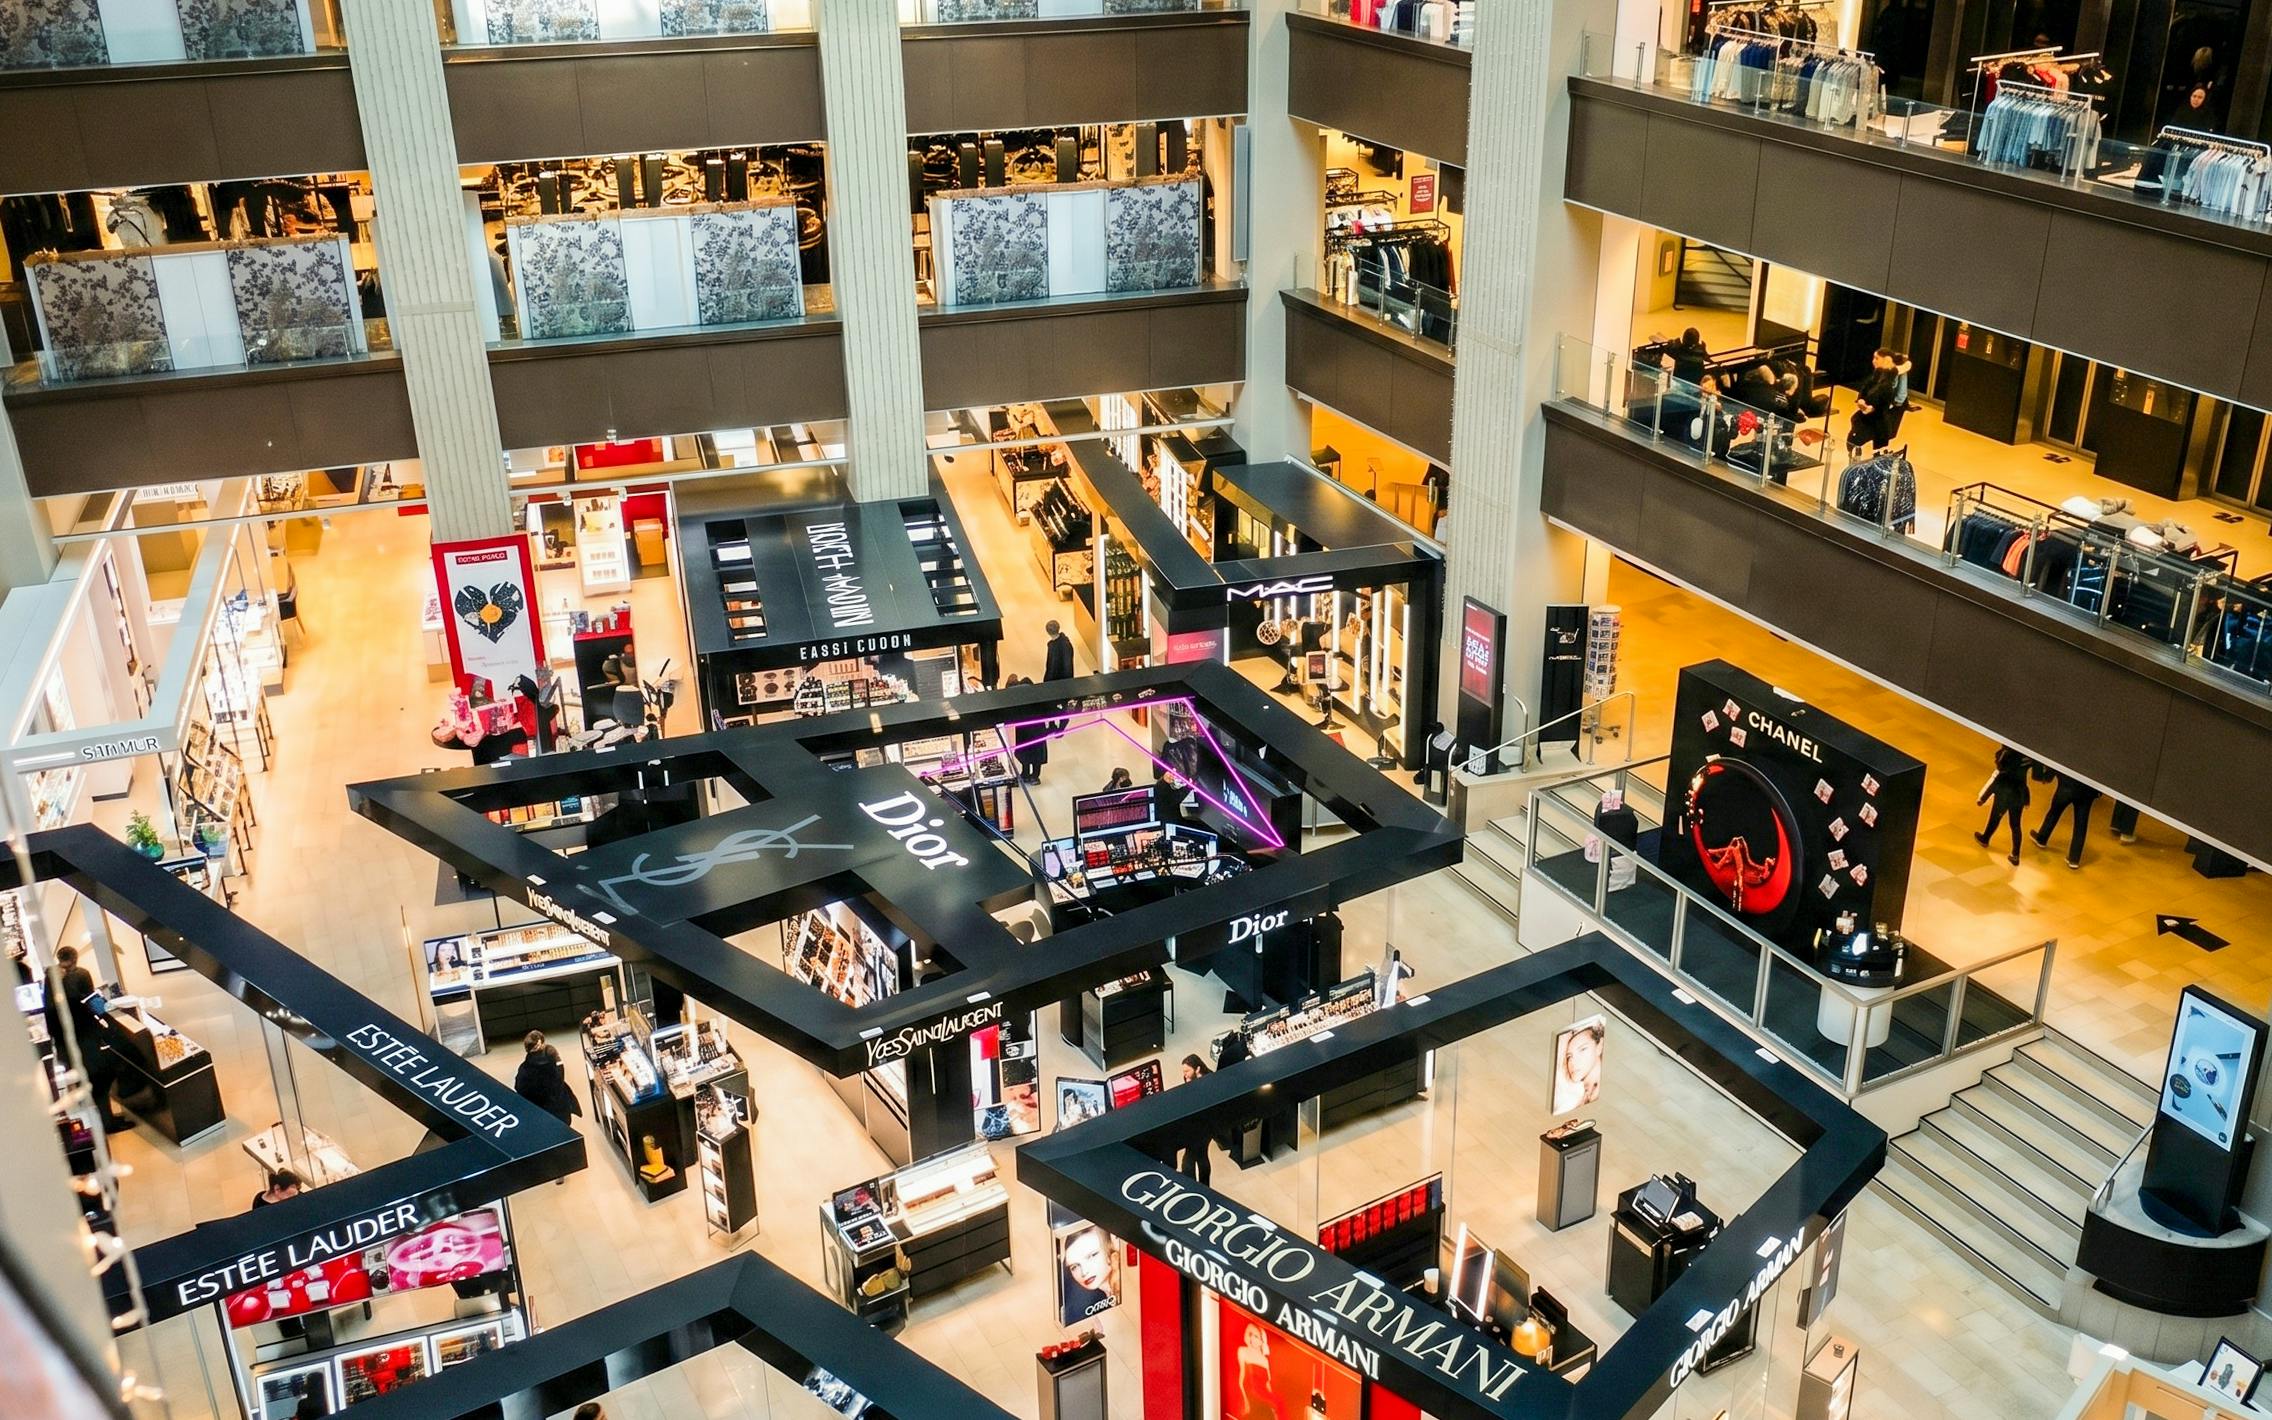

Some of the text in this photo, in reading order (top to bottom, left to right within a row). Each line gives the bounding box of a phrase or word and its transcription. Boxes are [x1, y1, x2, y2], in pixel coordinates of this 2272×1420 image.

[1748, 711, 1823, 764] CHANEL
[858, 790, 970, 871] Dior
[1228, 910, 1289, 944] Dior
[410, 1066, 520, 1138] LAUDER
[287, 1203, 420, 1267] LAUDER
[1121, 1170, 1529, 1402] GIORGIO ARMANI
[1165, 1238, 1381, 1381] GIORGIO ARMANI
